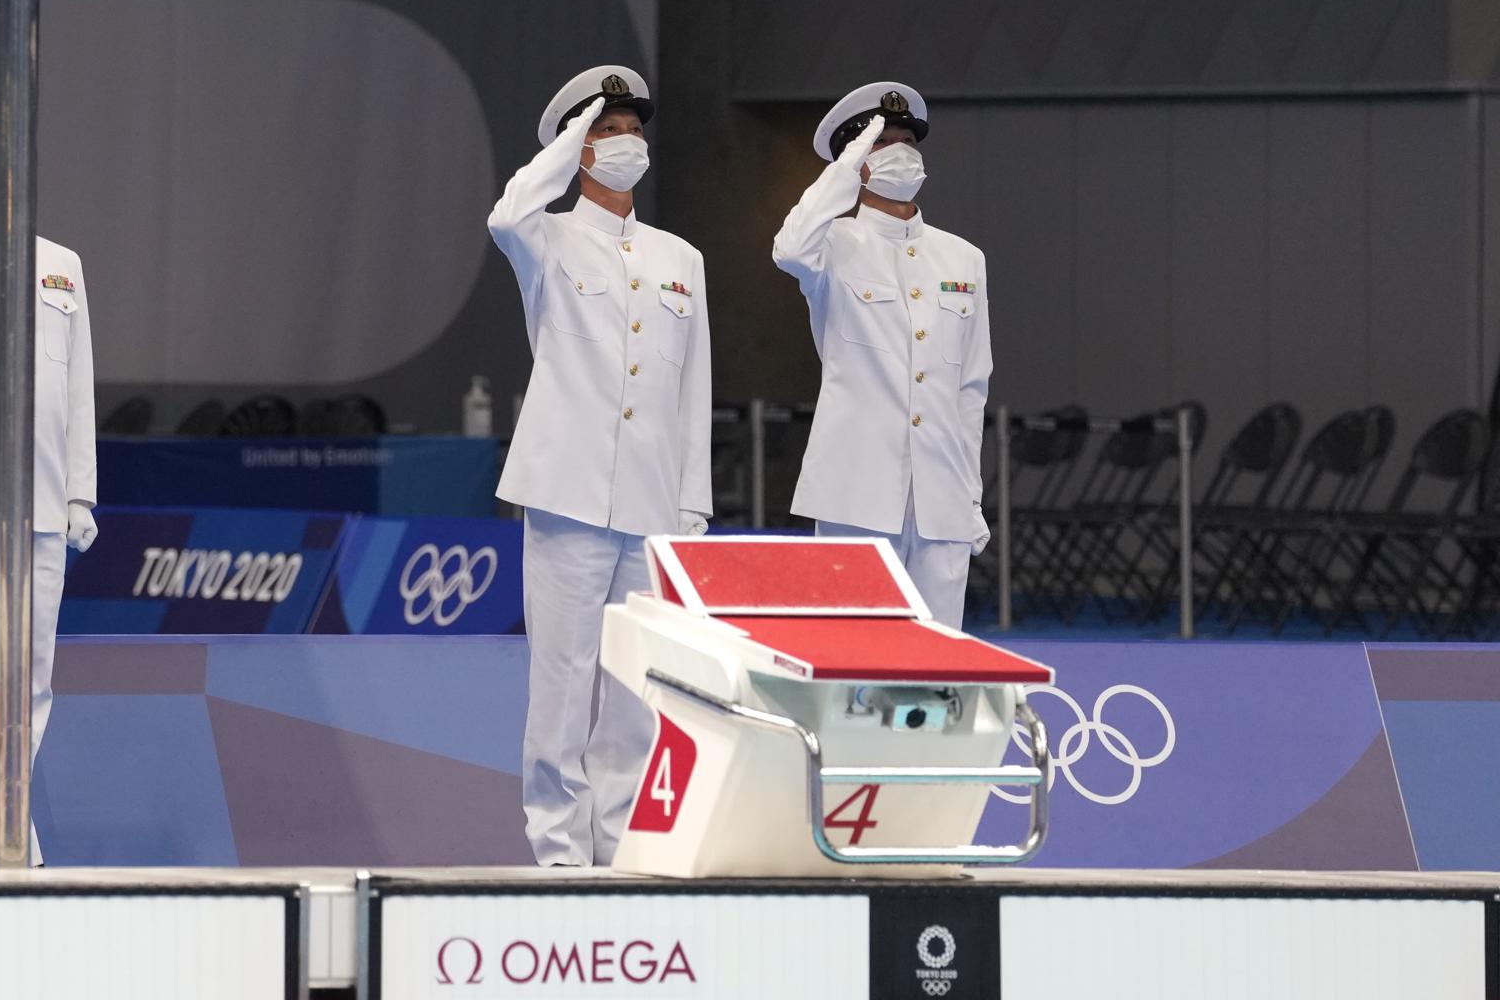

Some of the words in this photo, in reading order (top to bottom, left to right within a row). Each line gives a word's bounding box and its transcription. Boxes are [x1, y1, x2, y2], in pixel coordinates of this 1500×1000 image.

[132, 547, 232, 599] TOKYO
[221, 551, 303, 602] 2020
[651, 747, 675, 816] 4
[824, 783, 881, 845] 4
[501, 939, 697, 985] OMEGA
